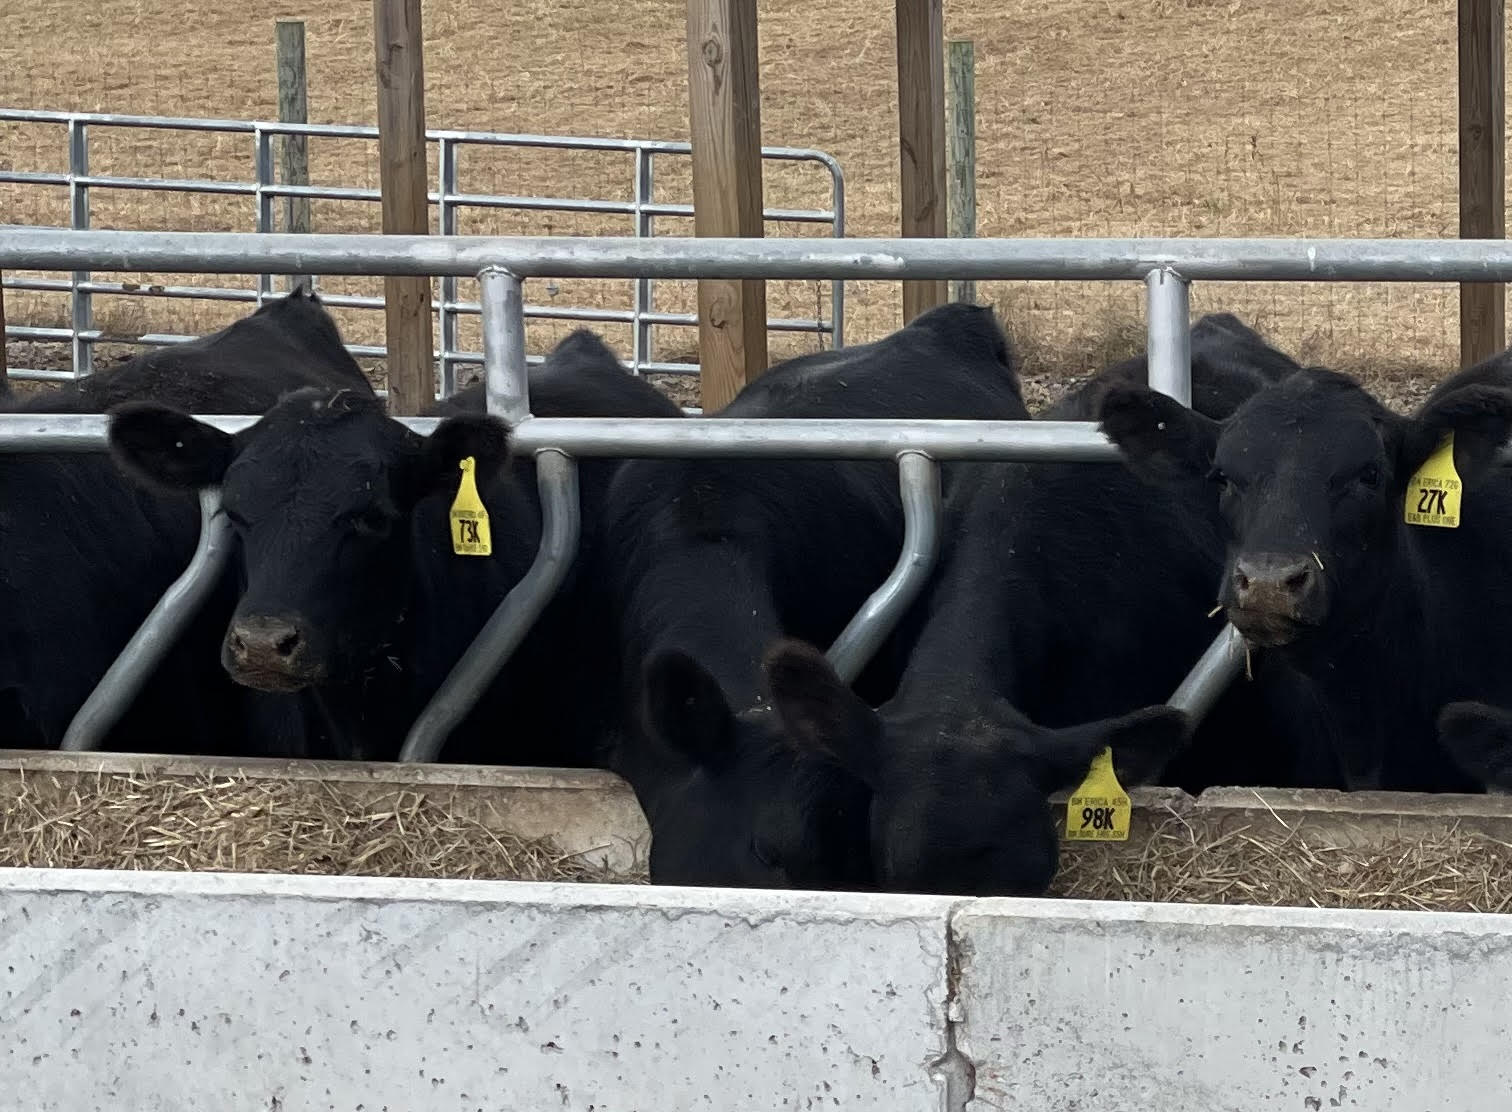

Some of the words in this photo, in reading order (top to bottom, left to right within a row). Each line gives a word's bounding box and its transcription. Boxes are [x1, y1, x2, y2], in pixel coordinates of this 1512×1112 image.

[1417, 488, 1448, 515] 27K
[459, 519, 481, 544] 73K
[1081, 807, 1116, 830] 98K
